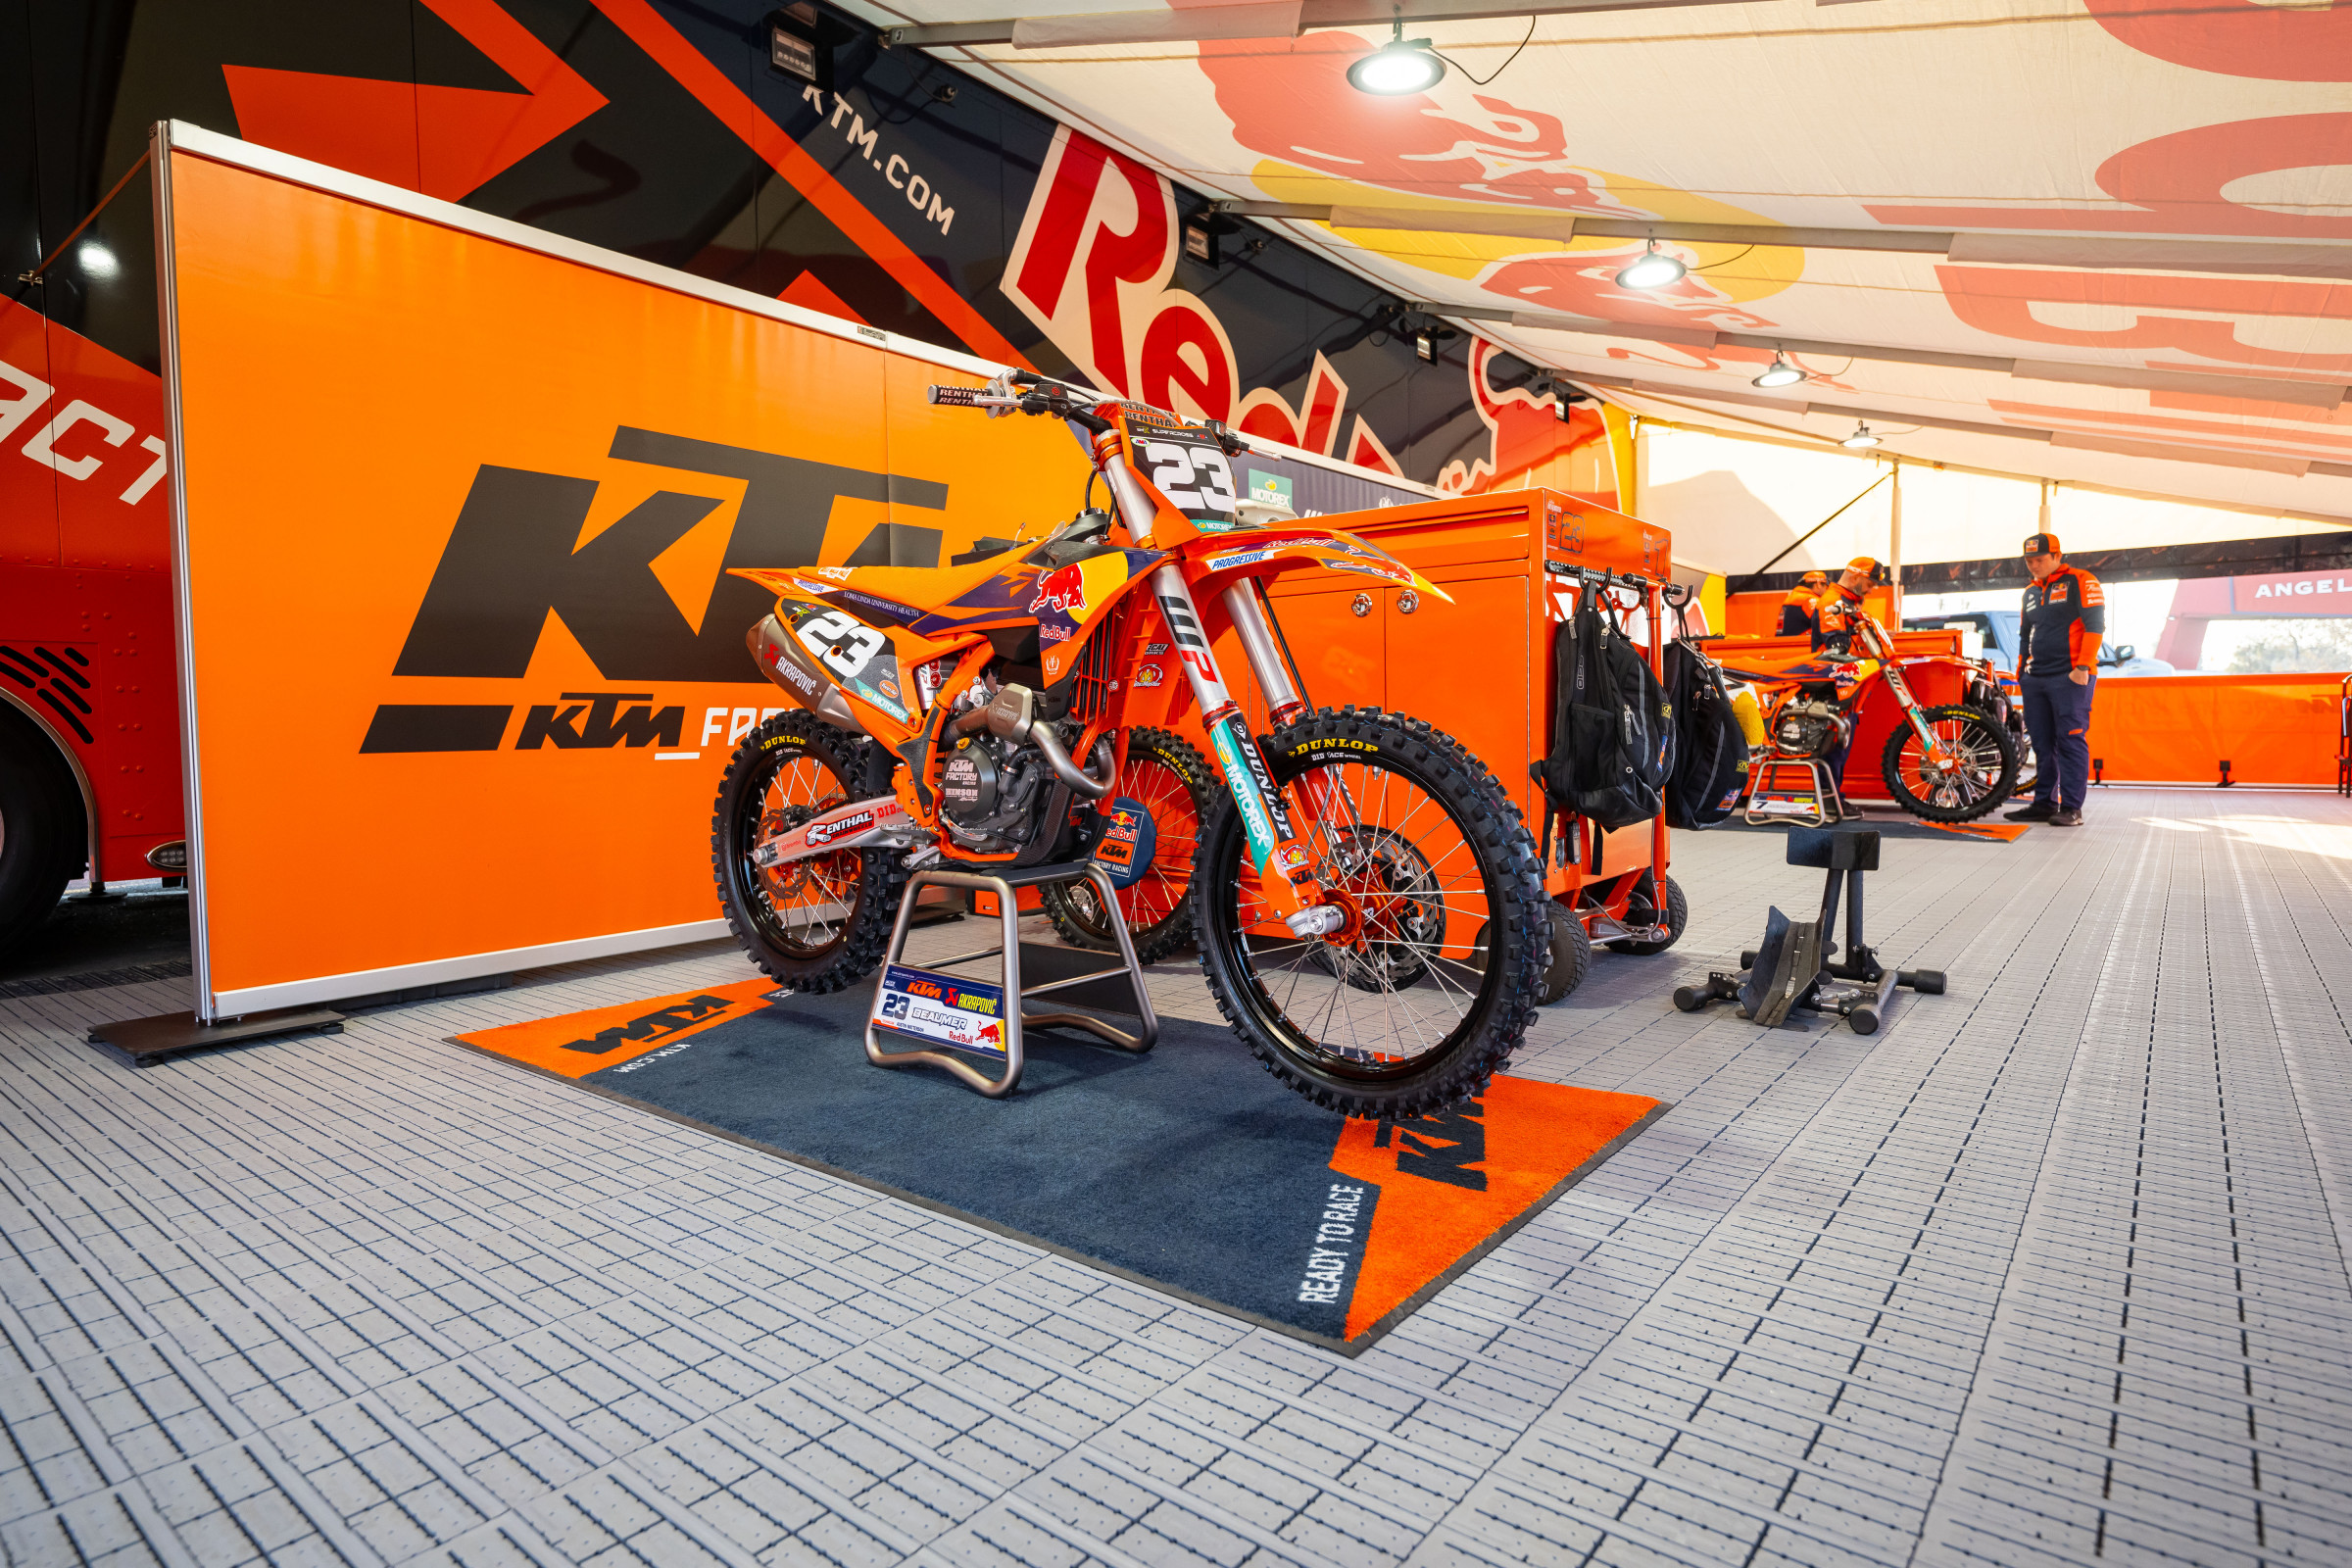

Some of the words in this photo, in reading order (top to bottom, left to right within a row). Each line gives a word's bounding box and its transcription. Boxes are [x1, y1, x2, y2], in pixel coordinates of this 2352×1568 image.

[1124, 411, 1176, 428] RENTHA
[1152, 428, 1195, 438] SUPERCROSS
[1145, 443, 1236, 514] 23
[1250, 486, 1291, 508] MOTOREX
[1559, 511, 1586, 555] 23
[391, 424, 949, 684] KT
[1212, 551, 1267, 569] PROGRESSIVE
[844, 591, 858, 601] LOMA
[858, 595, 871, 605] LINDA
[871, 599, 898, 612] UNIVERSITY
[898, 607, 920, 617] HEALTH
[796, 612, 886, 678] 23
[1040, 623, 1055, 639] Red
[1054, 625, 1071, 642] Bull
[1159, 596, 1219, 683] WP
[514, 692, 685, 750] KTM
[872, 693, 908, 723] MOTOREX
[764, 735, 807, 750] DUNLOP
[1296, 738, 1379, 756] DUNLOP
[945, 771, 978, 781] FACTORY
[948, 760, 974, 772] KTM
[1156, 748, 1194, 784] DUNLOP
[1242, 741, 1294, 840] DUNLOP
[876, 804, 897, 818] DID
[1225, 762, 1272, 847] MOTOREX
[1105, 826, 1118, 839] ed
[1118, 827, 1138, 842] Bull
[1100, 844, 1128, 859] KTM
[1094, 859, 1111, 870] FACTORY
[1111, 863, 1130, 874] RACING
[906, 980, 942, 999] KTM
[957, 993, 998, 1015] AKRAPOVIČ
[560, 994, 736, 1055] KTM
[882, 992, 910, 1020] 23
[911, 1006, 968, 1031] BEAUMER
[949, 1030, 961, 1043] Red
[960, 1032, 974, 1046] Bull
[1322, 1183, 1364, 1222] RACE
[1315, 1222, 1354, 1244] TO
[1298, 1246, 1349, 1304] READY
